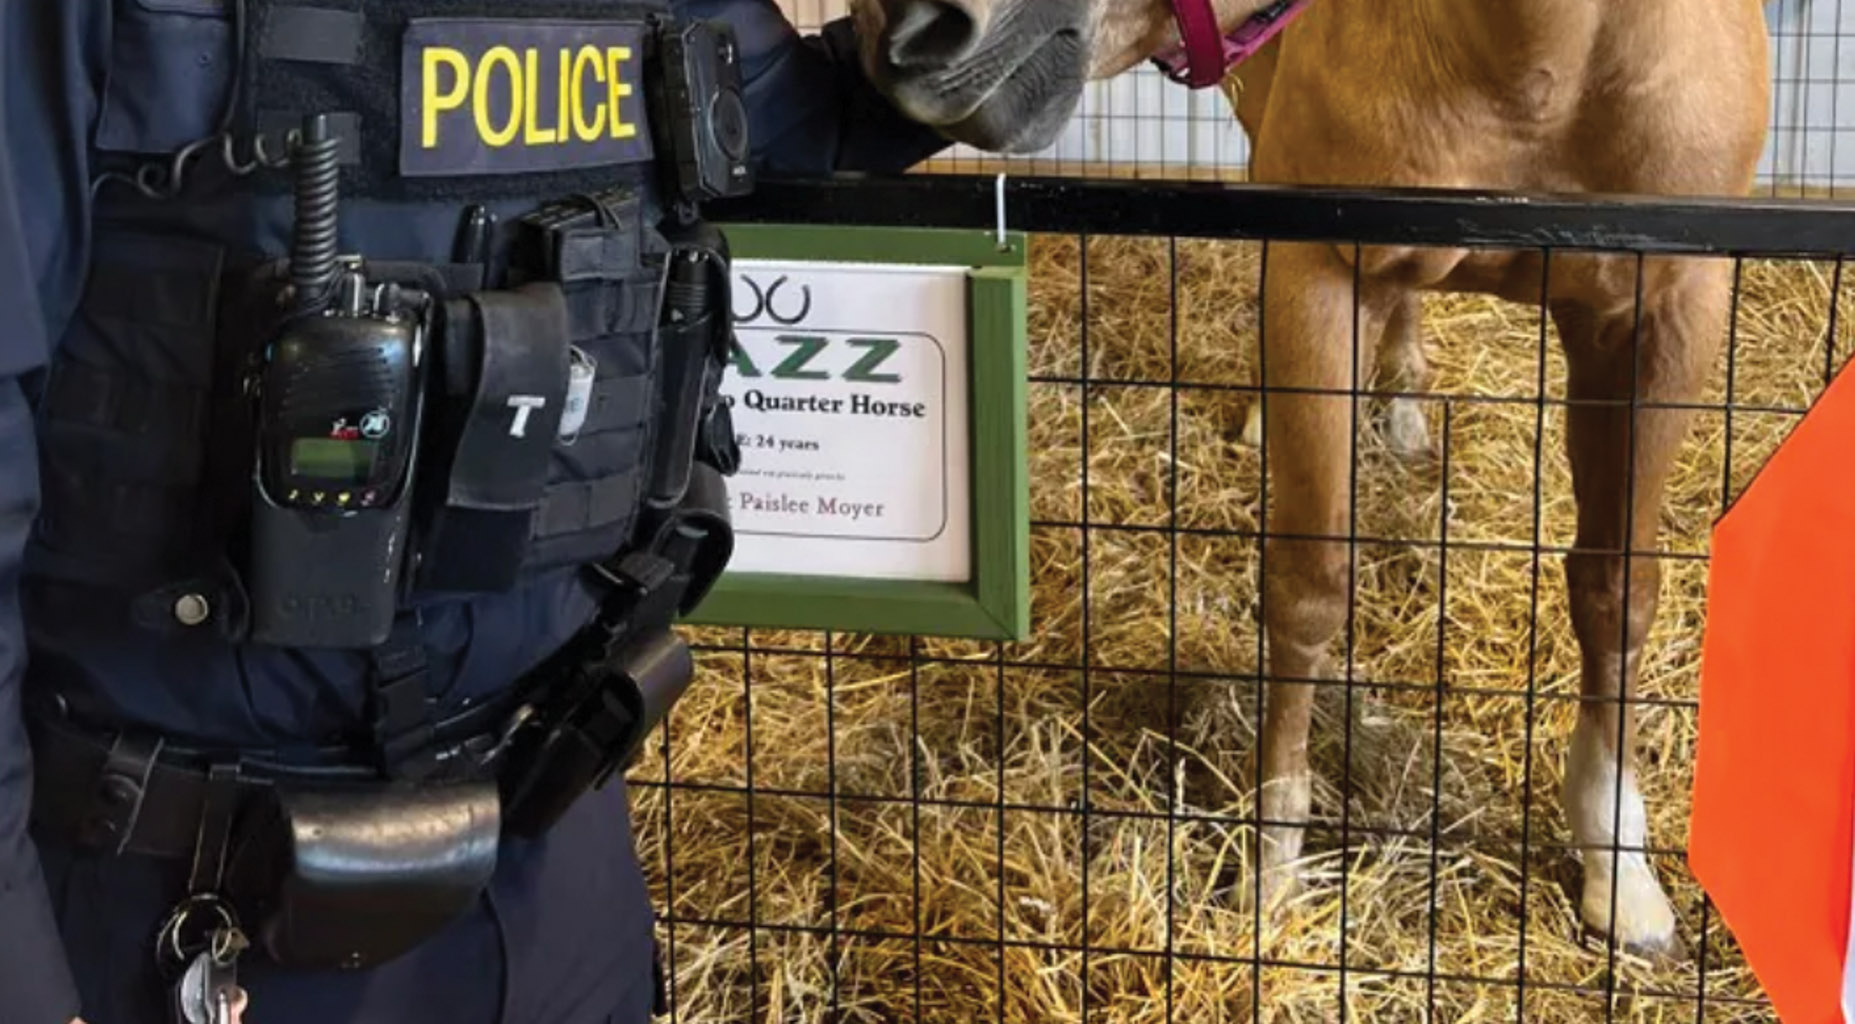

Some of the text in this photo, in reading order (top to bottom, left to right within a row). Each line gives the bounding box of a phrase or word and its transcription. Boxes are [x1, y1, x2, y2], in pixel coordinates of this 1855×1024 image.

[421, 46, 636, 149] POLICE
[727, 331, 902, 383] AZZ
[506, 394, 547, 439] T
[744, 389, 844, 412] Quarter
[851, 394, 926, 417] Horse
[756, 434, 775, 448] 24
[779, 439, 819, 452] years
[740, 492, 810, 514] Paislee
[816, 496, 885, 520] Moyer
